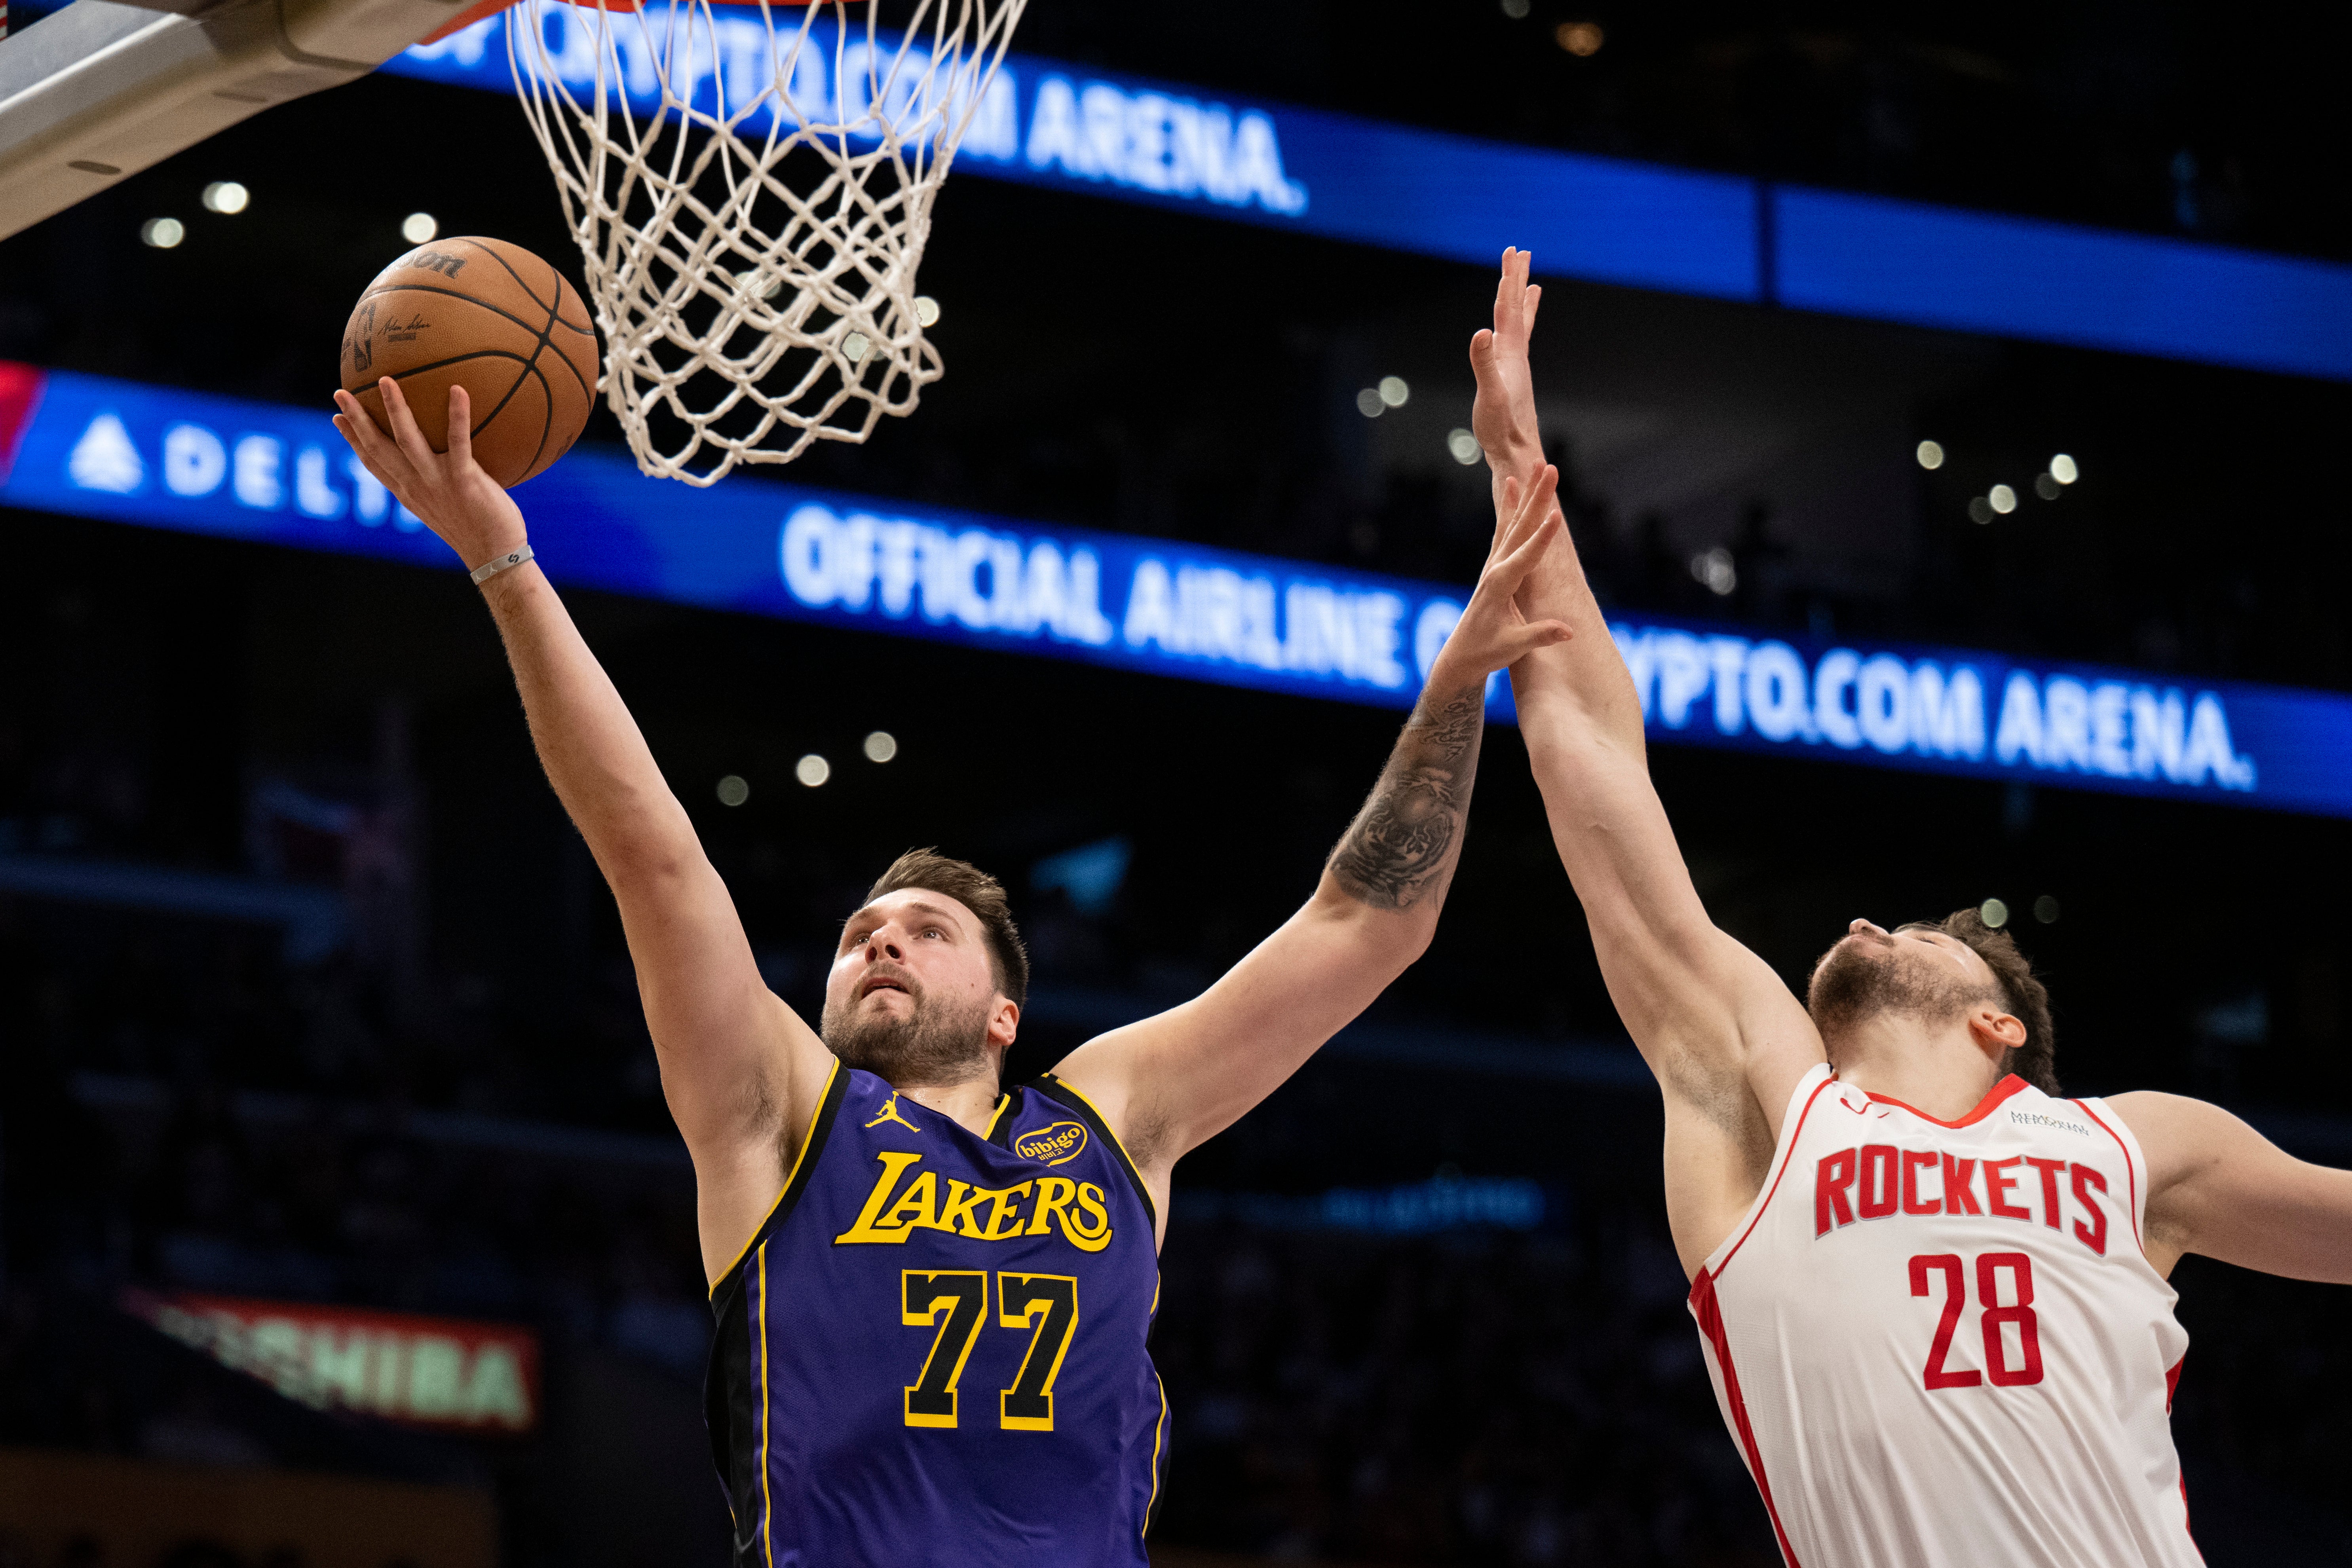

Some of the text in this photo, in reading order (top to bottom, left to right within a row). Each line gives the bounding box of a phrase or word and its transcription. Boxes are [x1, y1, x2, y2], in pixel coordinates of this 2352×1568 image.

[1028, 74, 1308, 216] ARENA.
[163, 419, 425, 533] DELT
[781, 503, 1112, 644] OFFICIAL
[1123, 557, 1407, 689] AIRLINE
[1609, 622, 1986, 763] YPTO.COM
[1995, 669, 2258, 792] ARENA.
[1020, 1128, 1080, 1157] bibigo
[1038, 1148, 1065, 1161] 비비고
[2011, 1111, 2086, 1131] MEMORIAL
[833, 1151, 1113, 1253] LAKERS
[1815, 1143, 2109, 1257] ROCKETS
[902, 1269, 1079, 1431] 77
[1907, 1252, 2044, 1390] 28
